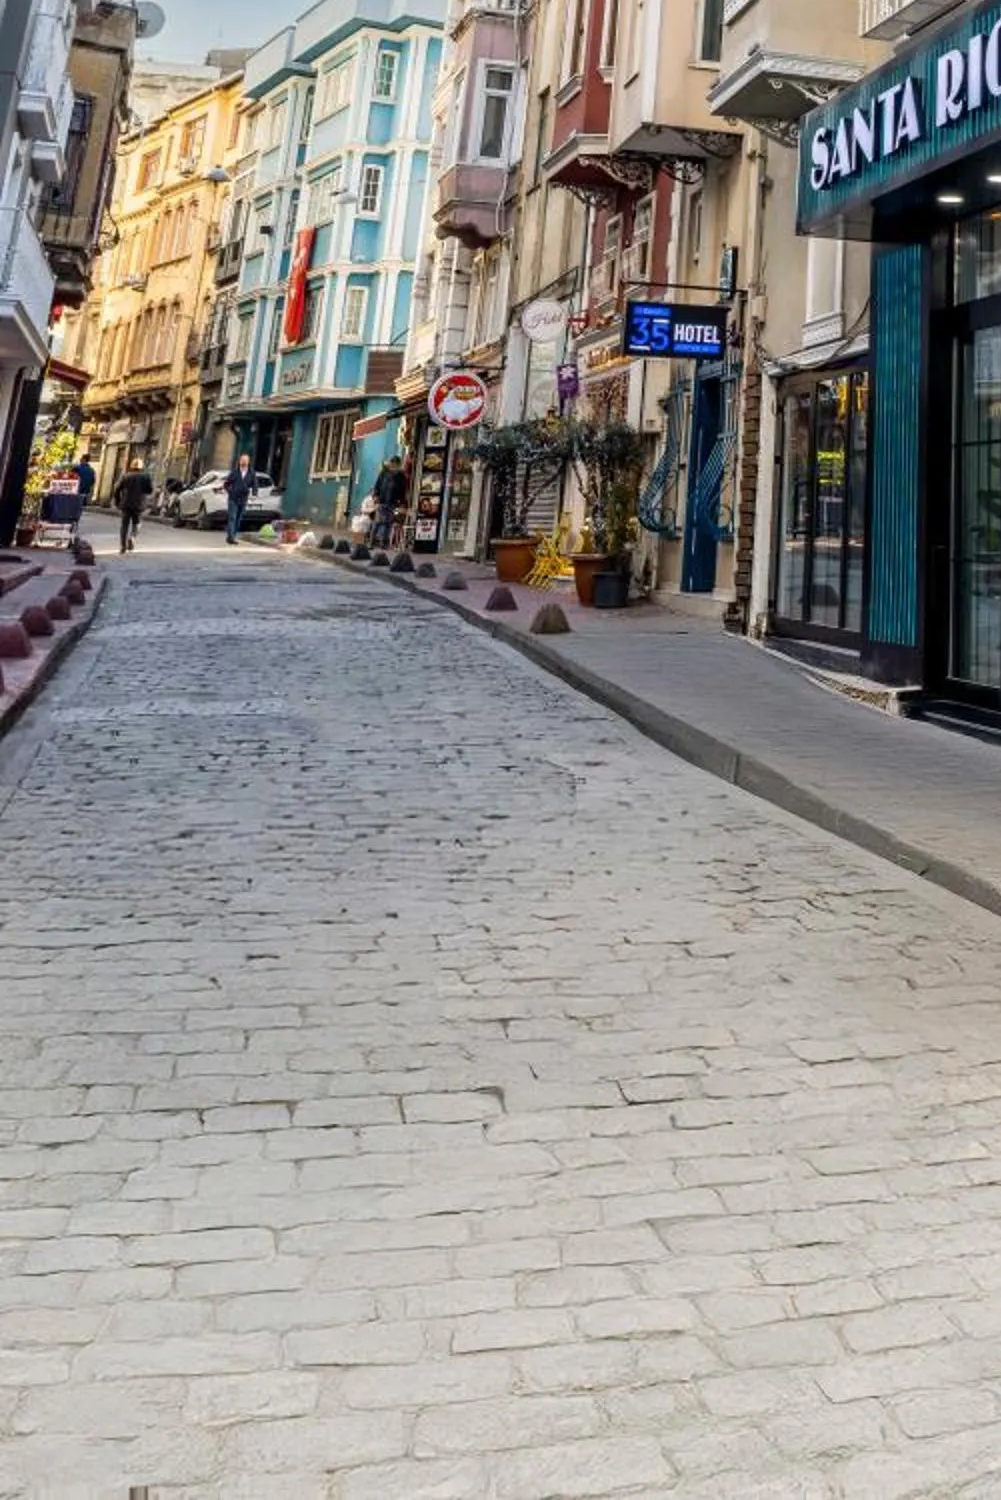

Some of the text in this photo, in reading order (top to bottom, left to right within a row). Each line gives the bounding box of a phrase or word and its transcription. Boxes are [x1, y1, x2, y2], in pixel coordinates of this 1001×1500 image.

[811, 77, 920, 190] SANTA
[631, 317, 721, 351] 35 HOTEL
